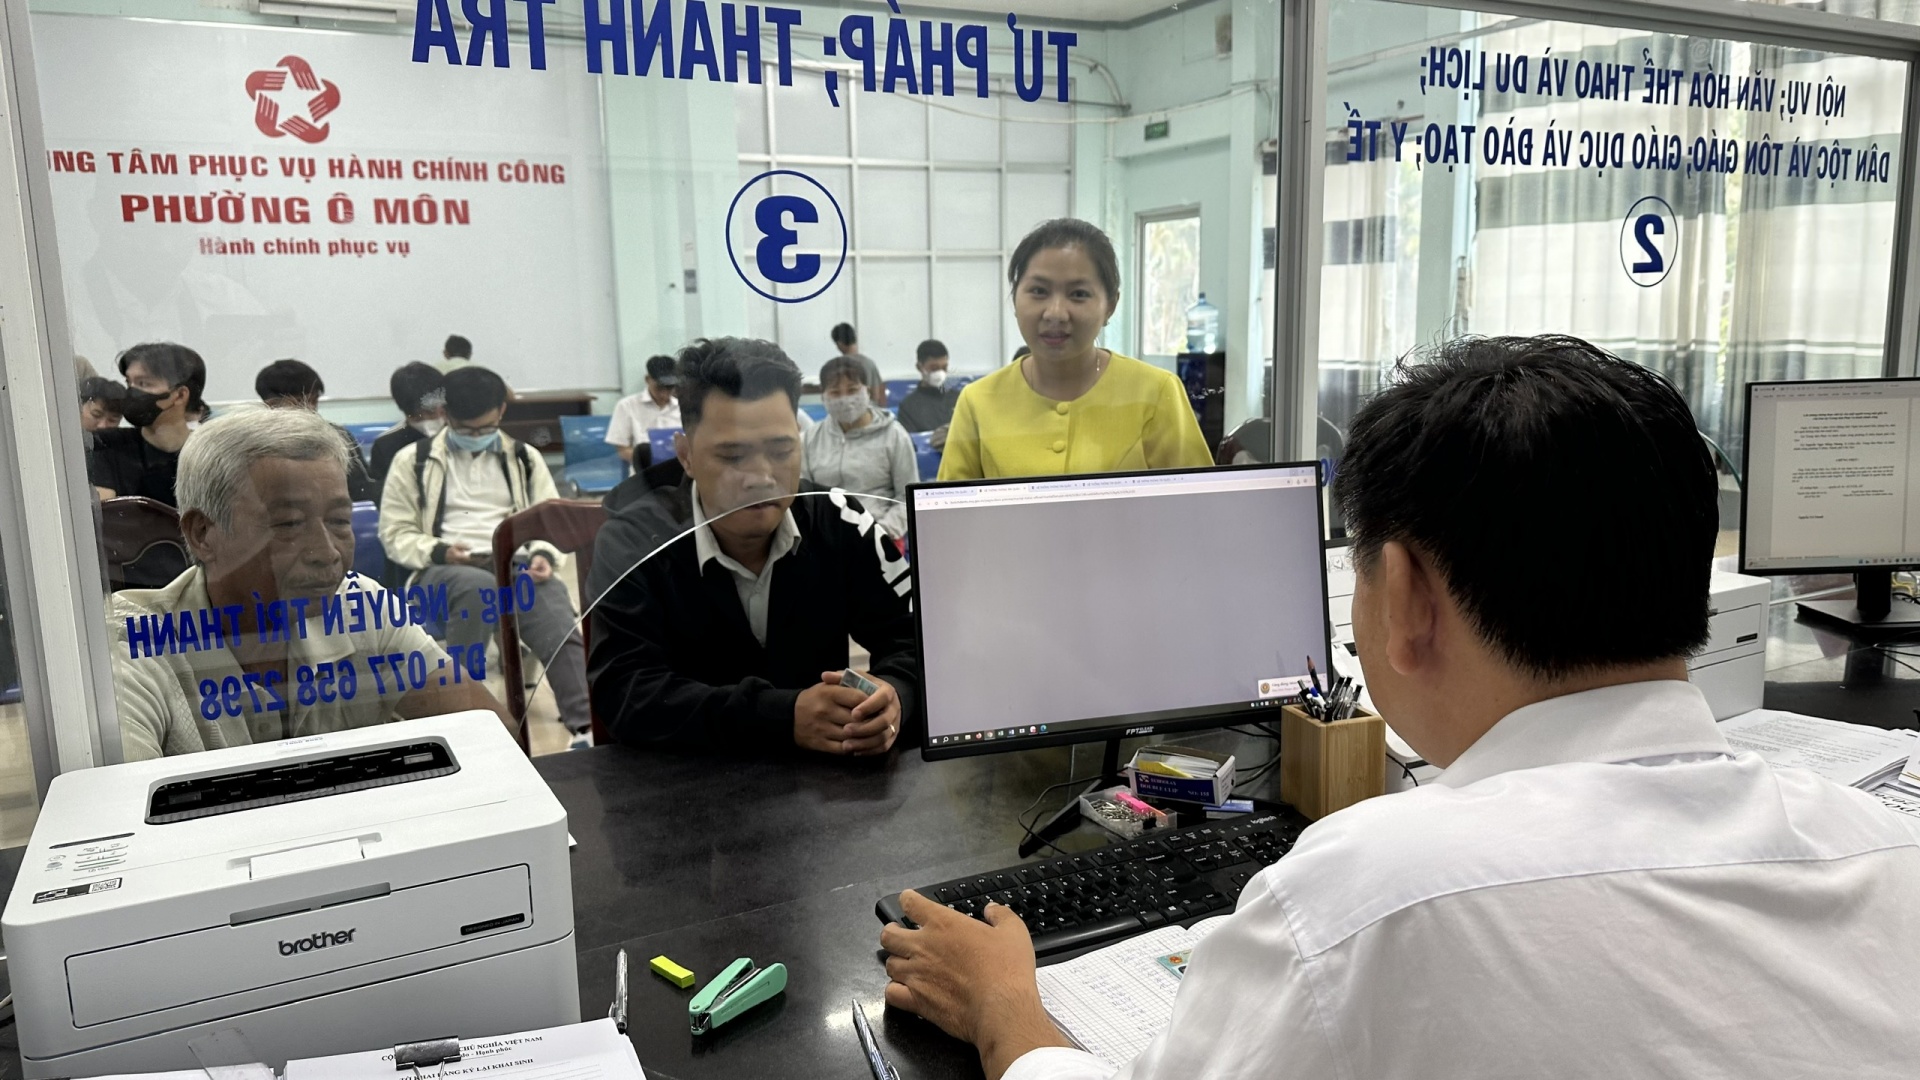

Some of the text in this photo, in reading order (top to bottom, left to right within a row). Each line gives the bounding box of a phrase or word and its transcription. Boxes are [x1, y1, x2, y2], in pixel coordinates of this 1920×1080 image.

[106, 147, 179, 175] TÂM
[188, 153, 269, 182] PHỤC
[278, 156, 317, 183] VỤ
[327, 153, 404, 180] HÀNH
[412, 156, 489, 182] CHÍNH
[497, 158, 566, 185] CÔNG
[120, 189, 471, 226] PHƯỜNG Ô MÔN
[199, 236, 412, 260] Hành chính phục vụ
[278, 927, 357, 957] brother
[514, 1058, 534, 1066] SINH
